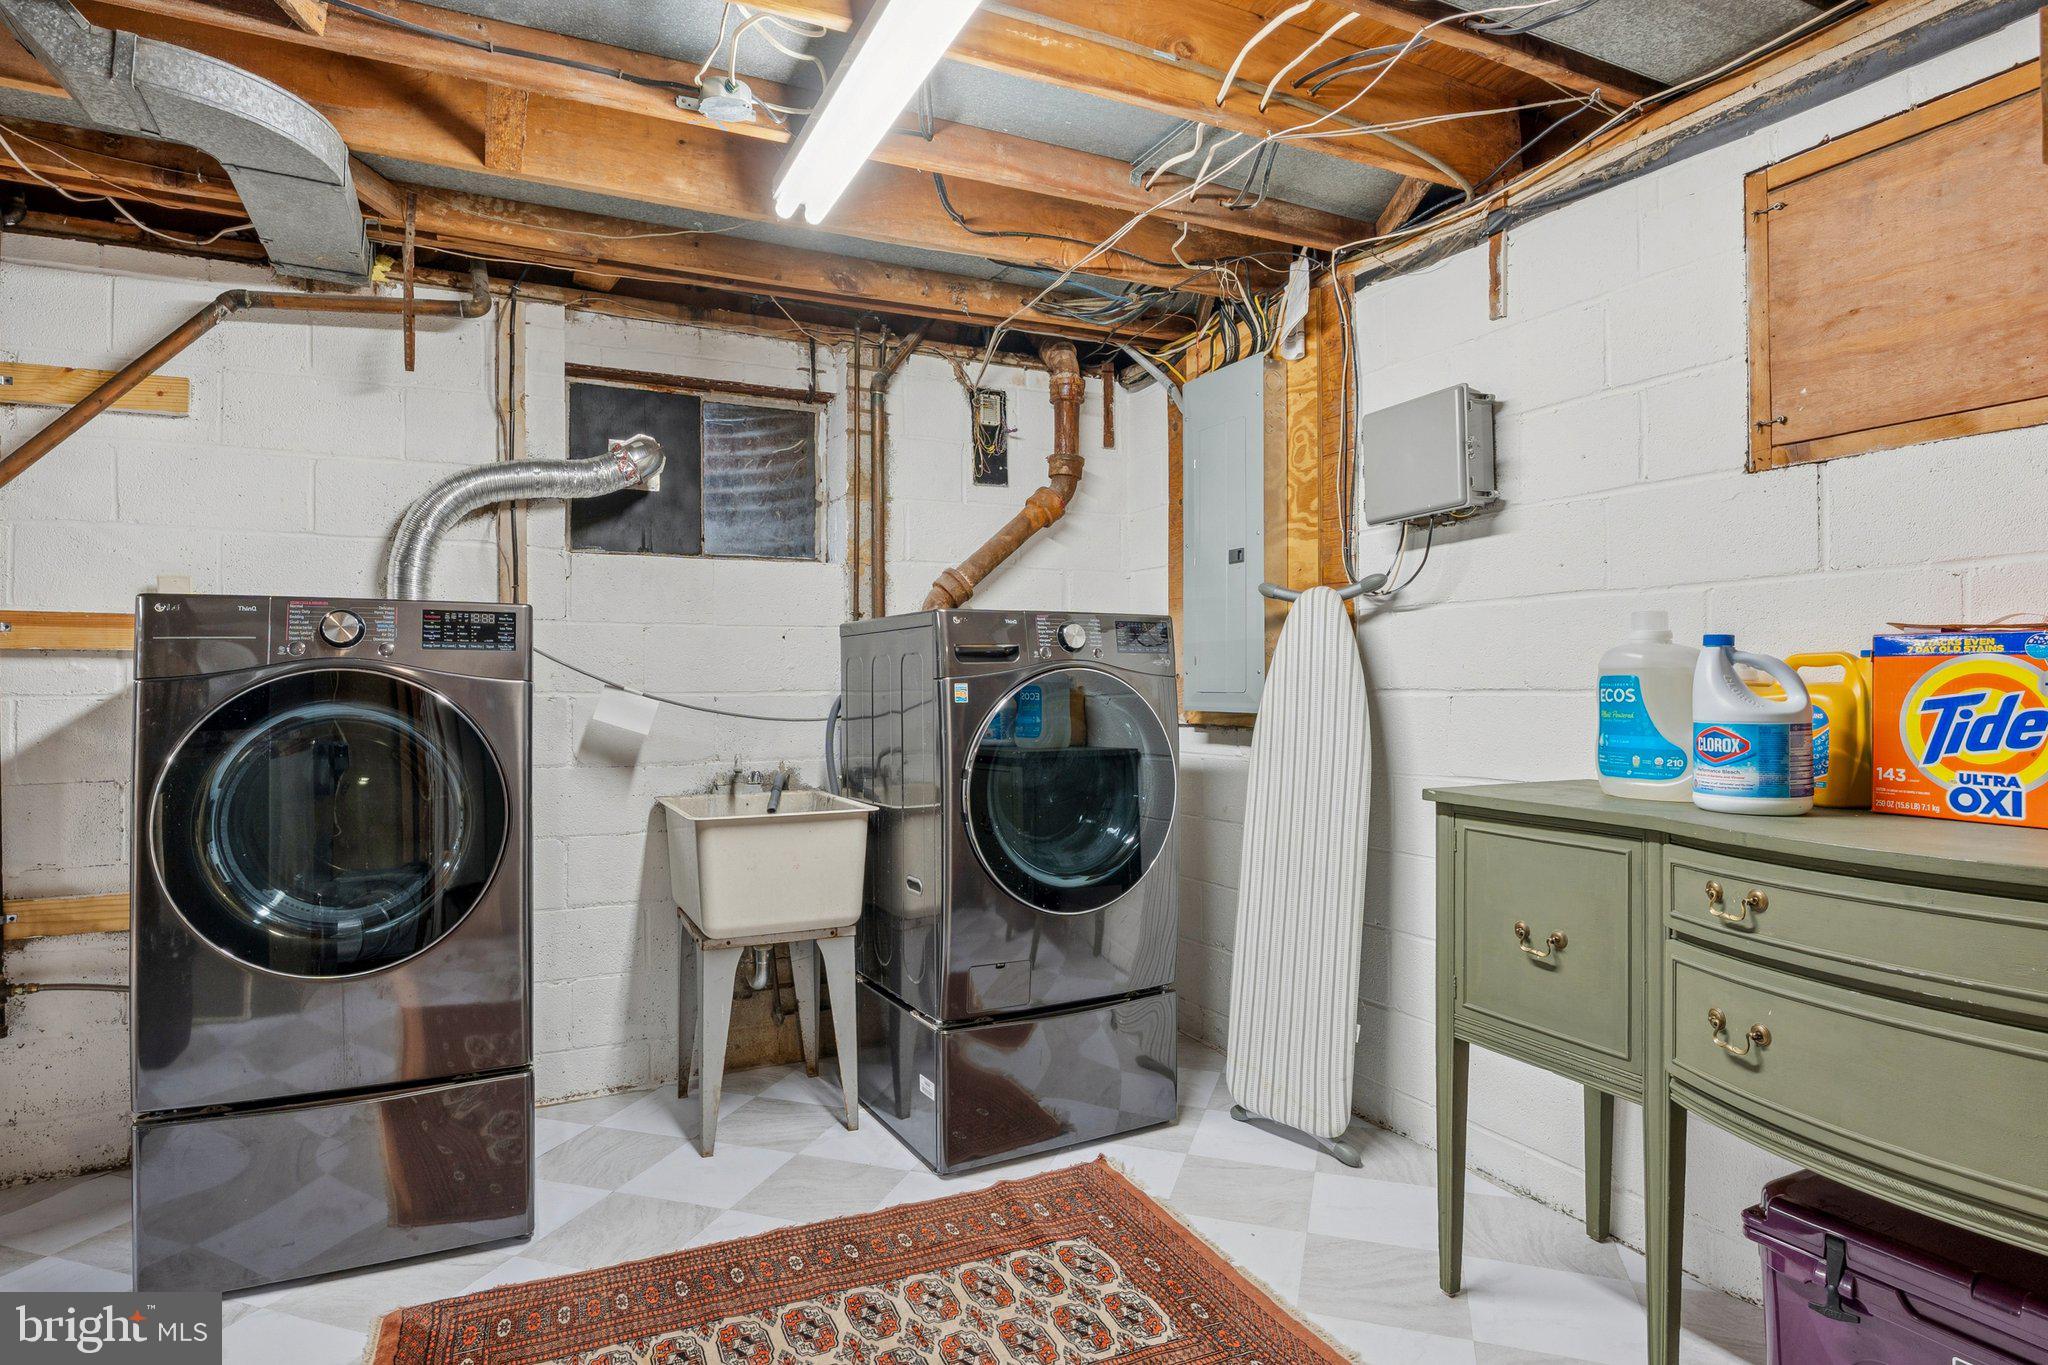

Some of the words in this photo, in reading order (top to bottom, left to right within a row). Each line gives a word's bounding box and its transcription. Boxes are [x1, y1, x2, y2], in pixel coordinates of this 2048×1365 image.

[1913, 638, 1962, 647] ATTACKS
[1964, 637, 1995, 645] EVEN
[1915, 645, 1936, 653] DAY
[1938, 645, 1961, 653] OLD
[1964, 644, 2005, 653] STAINS
[1600, 688, 1636, 703] ECOS
[1920, 691, 2048, 765] Tide
[1697, 736, 1741, 753] CLOROX
[1666, 759, 1684, 767] 210
[1876, 767, 1907, 782] 143
[1958, 772, 2020, 788] ULTRA
[1886, 800, 1894, 808] OZ
[1931, 804, 1940, 813] kg
[1949, 786, 2023, 818] OXI
